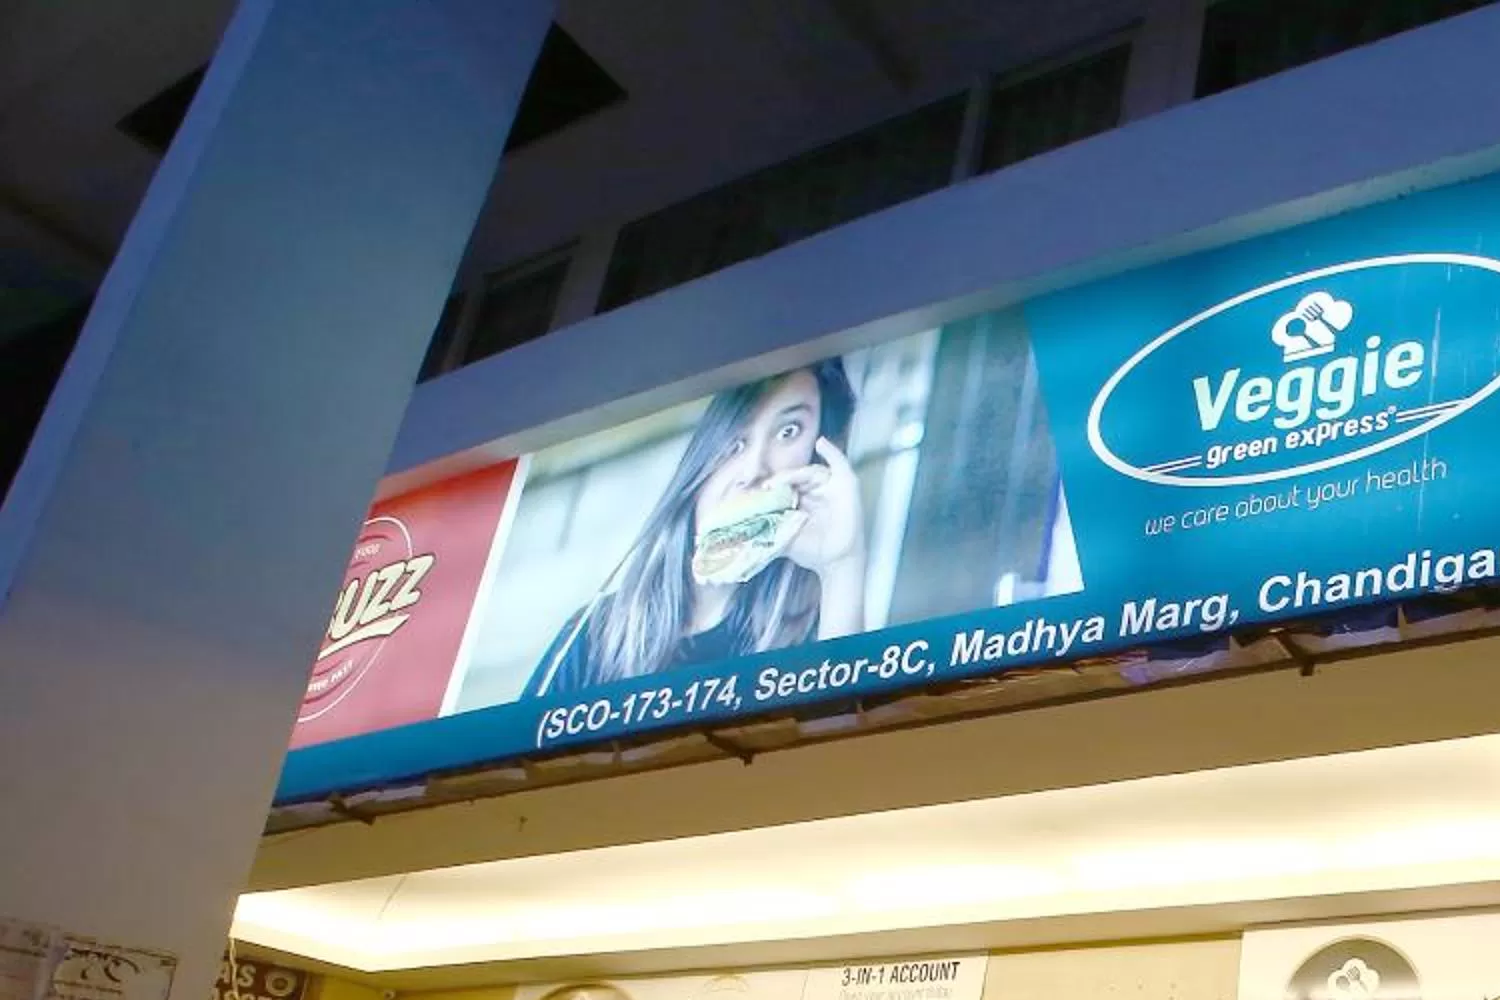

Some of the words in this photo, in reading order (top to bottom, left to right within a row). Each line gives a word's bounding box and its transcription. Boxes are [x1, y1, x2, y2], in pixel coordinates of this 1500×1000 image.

[1192, 335, 1425, 433] Veggie
[1205, 435, 1278, 470] green
[1145, 513, 1176, 538] we
[1181, 502, 1230, 529] care
[1234, 486, 1301, 520] about
[1306, 475, 1360, 511] your
[1364, 456, 1448, 493] health
[328, 552, 437, 642] UZZ
[536, 678, 743, 749] (SCO-173-174,
[755, 639, 936, 702] Sector-8C,
[950, 612, 1105, 667] Madhya
[1119, 591, 1240, 638] Marg,
[841, 964, 885, 987] 3-IN-1
[889, 961, 961, 984] ACCOUNT
